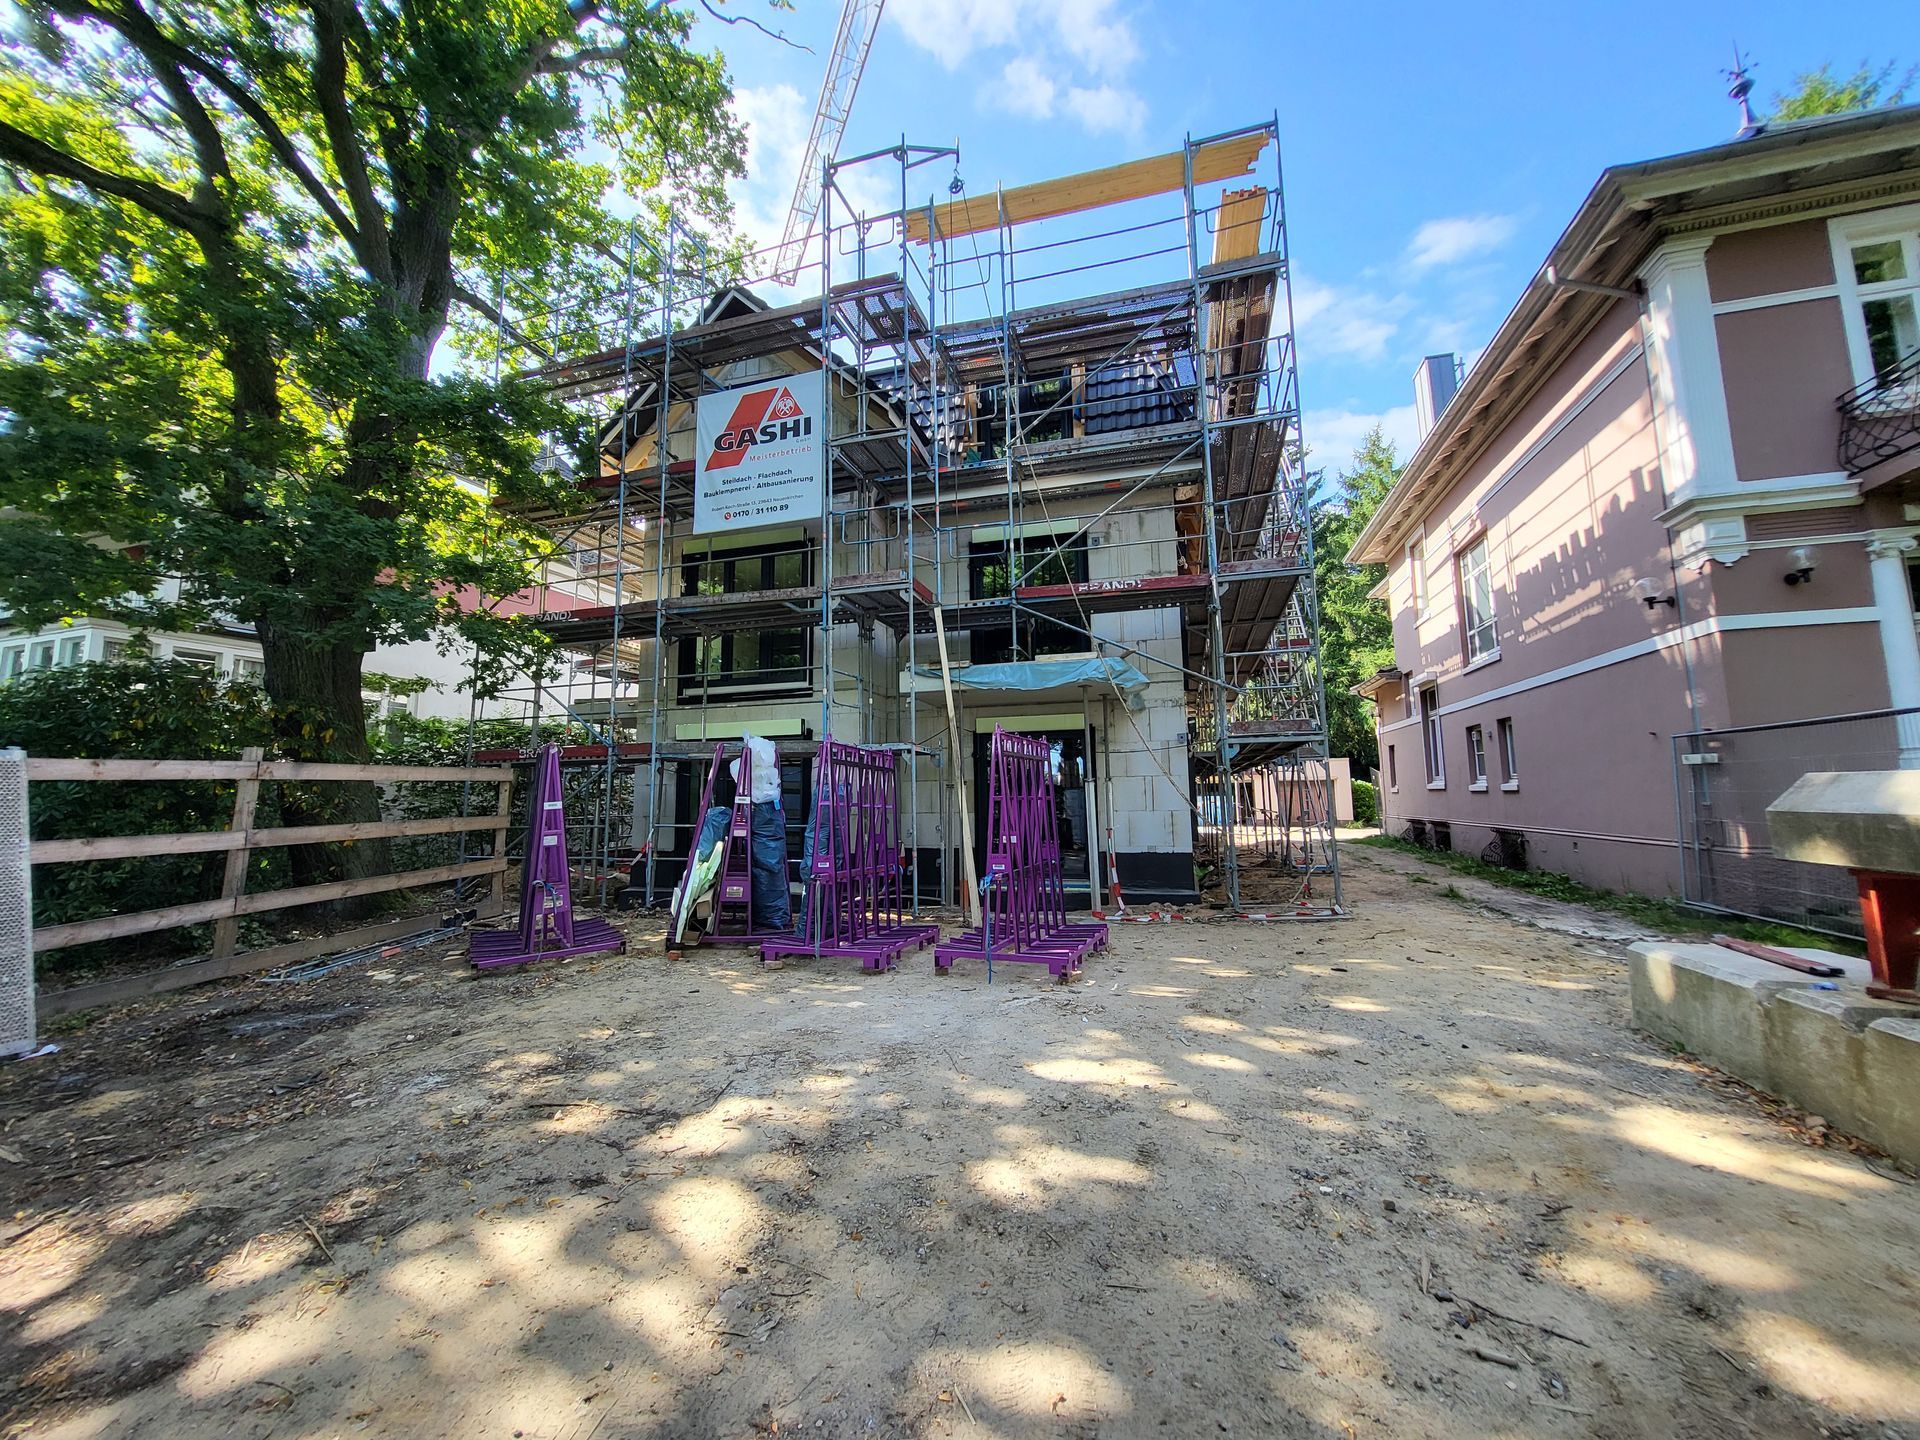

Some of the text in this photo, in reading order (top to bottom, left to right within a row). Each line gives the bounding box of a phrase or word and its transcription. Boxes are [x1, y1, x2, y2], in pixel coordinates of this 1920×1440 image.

[714, 416, 812, 452] GASHI
[749, 445, 812, 462] Meisterbetrieb
[721, 475, 752, 486] Steildach
[757, 468, 792, 479] Flachdach
[703, 485, 751, 499] Bauklempnerei
[756, 475, 814, 490] Altbausanierung
[732, 510, 750, 518] 0170
[755, 507, 764, 515] 31
[766, 505, 778, 513] 110
[779, 504, 789, 512] 89
